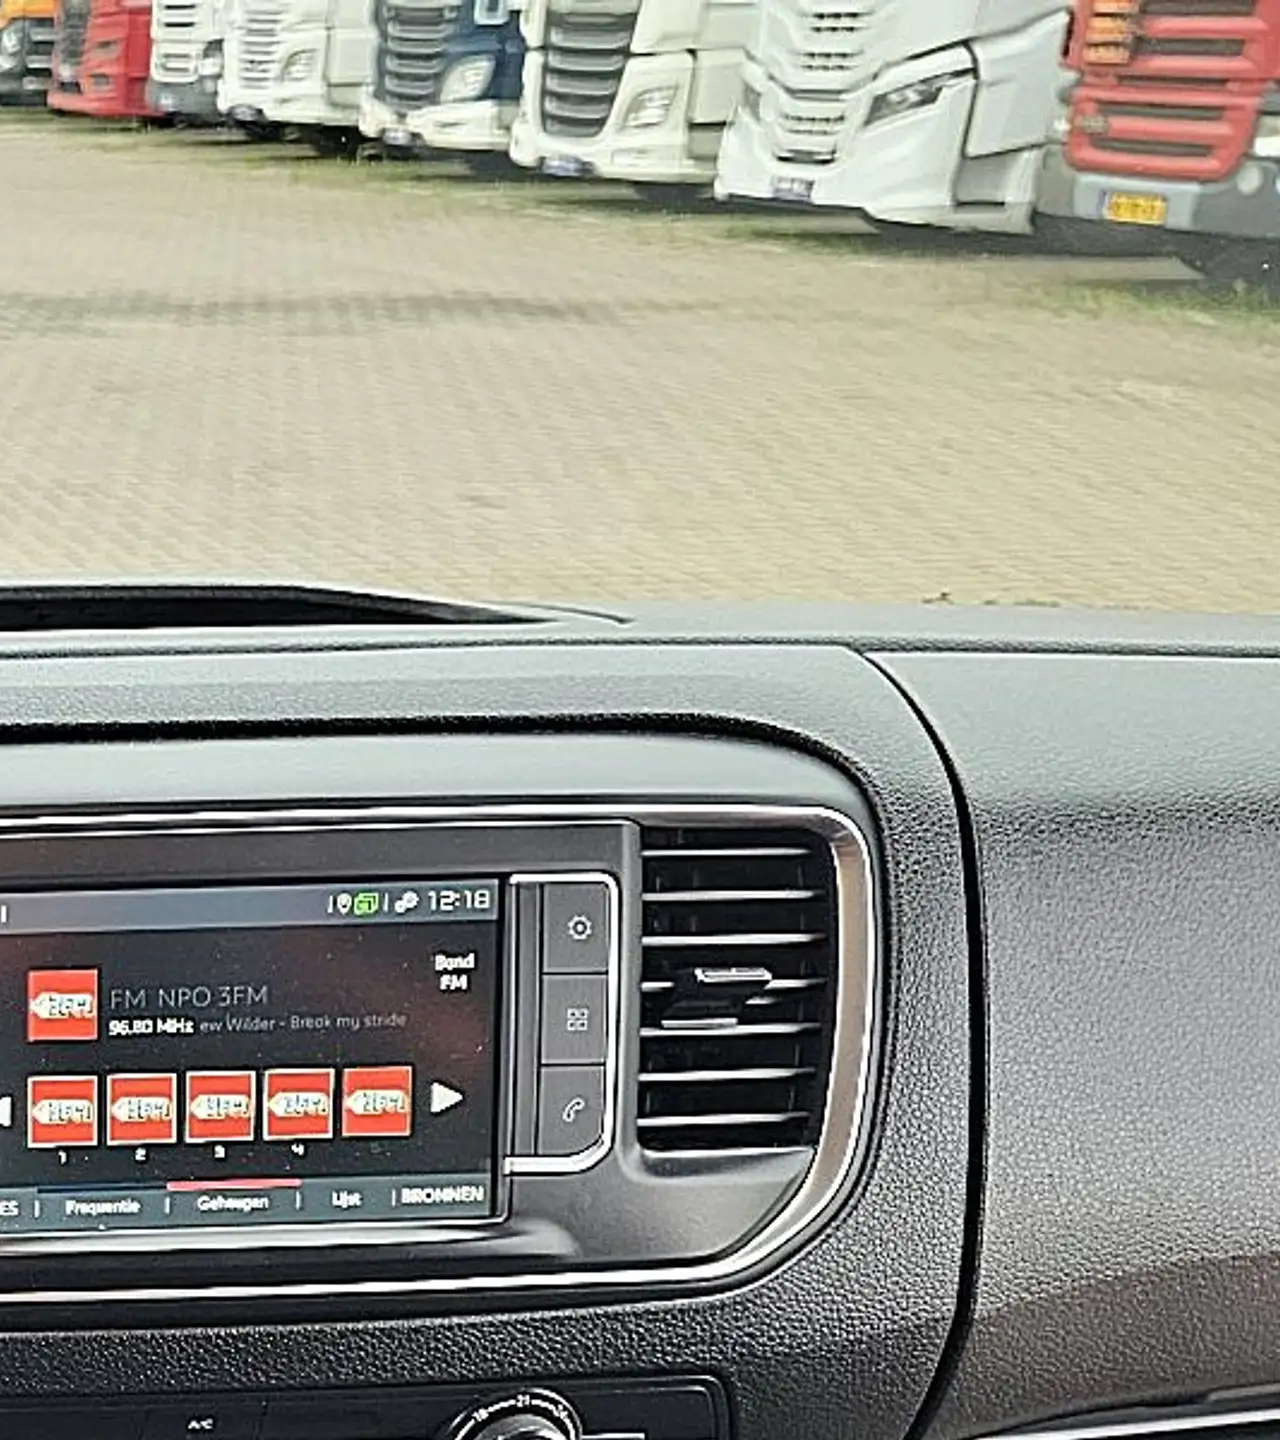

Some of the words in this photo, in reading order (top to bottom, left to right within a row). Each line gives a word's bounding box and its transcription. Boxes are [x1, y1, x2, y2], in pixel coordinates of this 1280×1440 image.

[428, 891, 490, 912] 12:18
[435, 952, 476, 971] Band
[440, 974, 468, 990] FM
[110, 989, 147, 1010] FM
[158, 986, 211, 1009] NPO
[218, 985, 269, 1008] 3FM
[108, 1019, 154, 1037] 96.80
[156, 1018, 195, 1035] MHz
[225, 1013, 276, 1033] Wilder
[290, 1013, 332, 1030] Break
[336, 1017, 362, 1034] my
[363, 1012, 407, 1029] stride
[134, 1147, 147, 1161] 2
[213, 1145, 226, 1159] 3
[291, 1143, 306, 1157] 4
[64, 1197, 142, 1217] Frequentie
[196, 1193, 270, 1213] Geheugen
[331, 1190, 363, 1209] Lijst
[400, 1184, 485, 1205] BRONNEN
